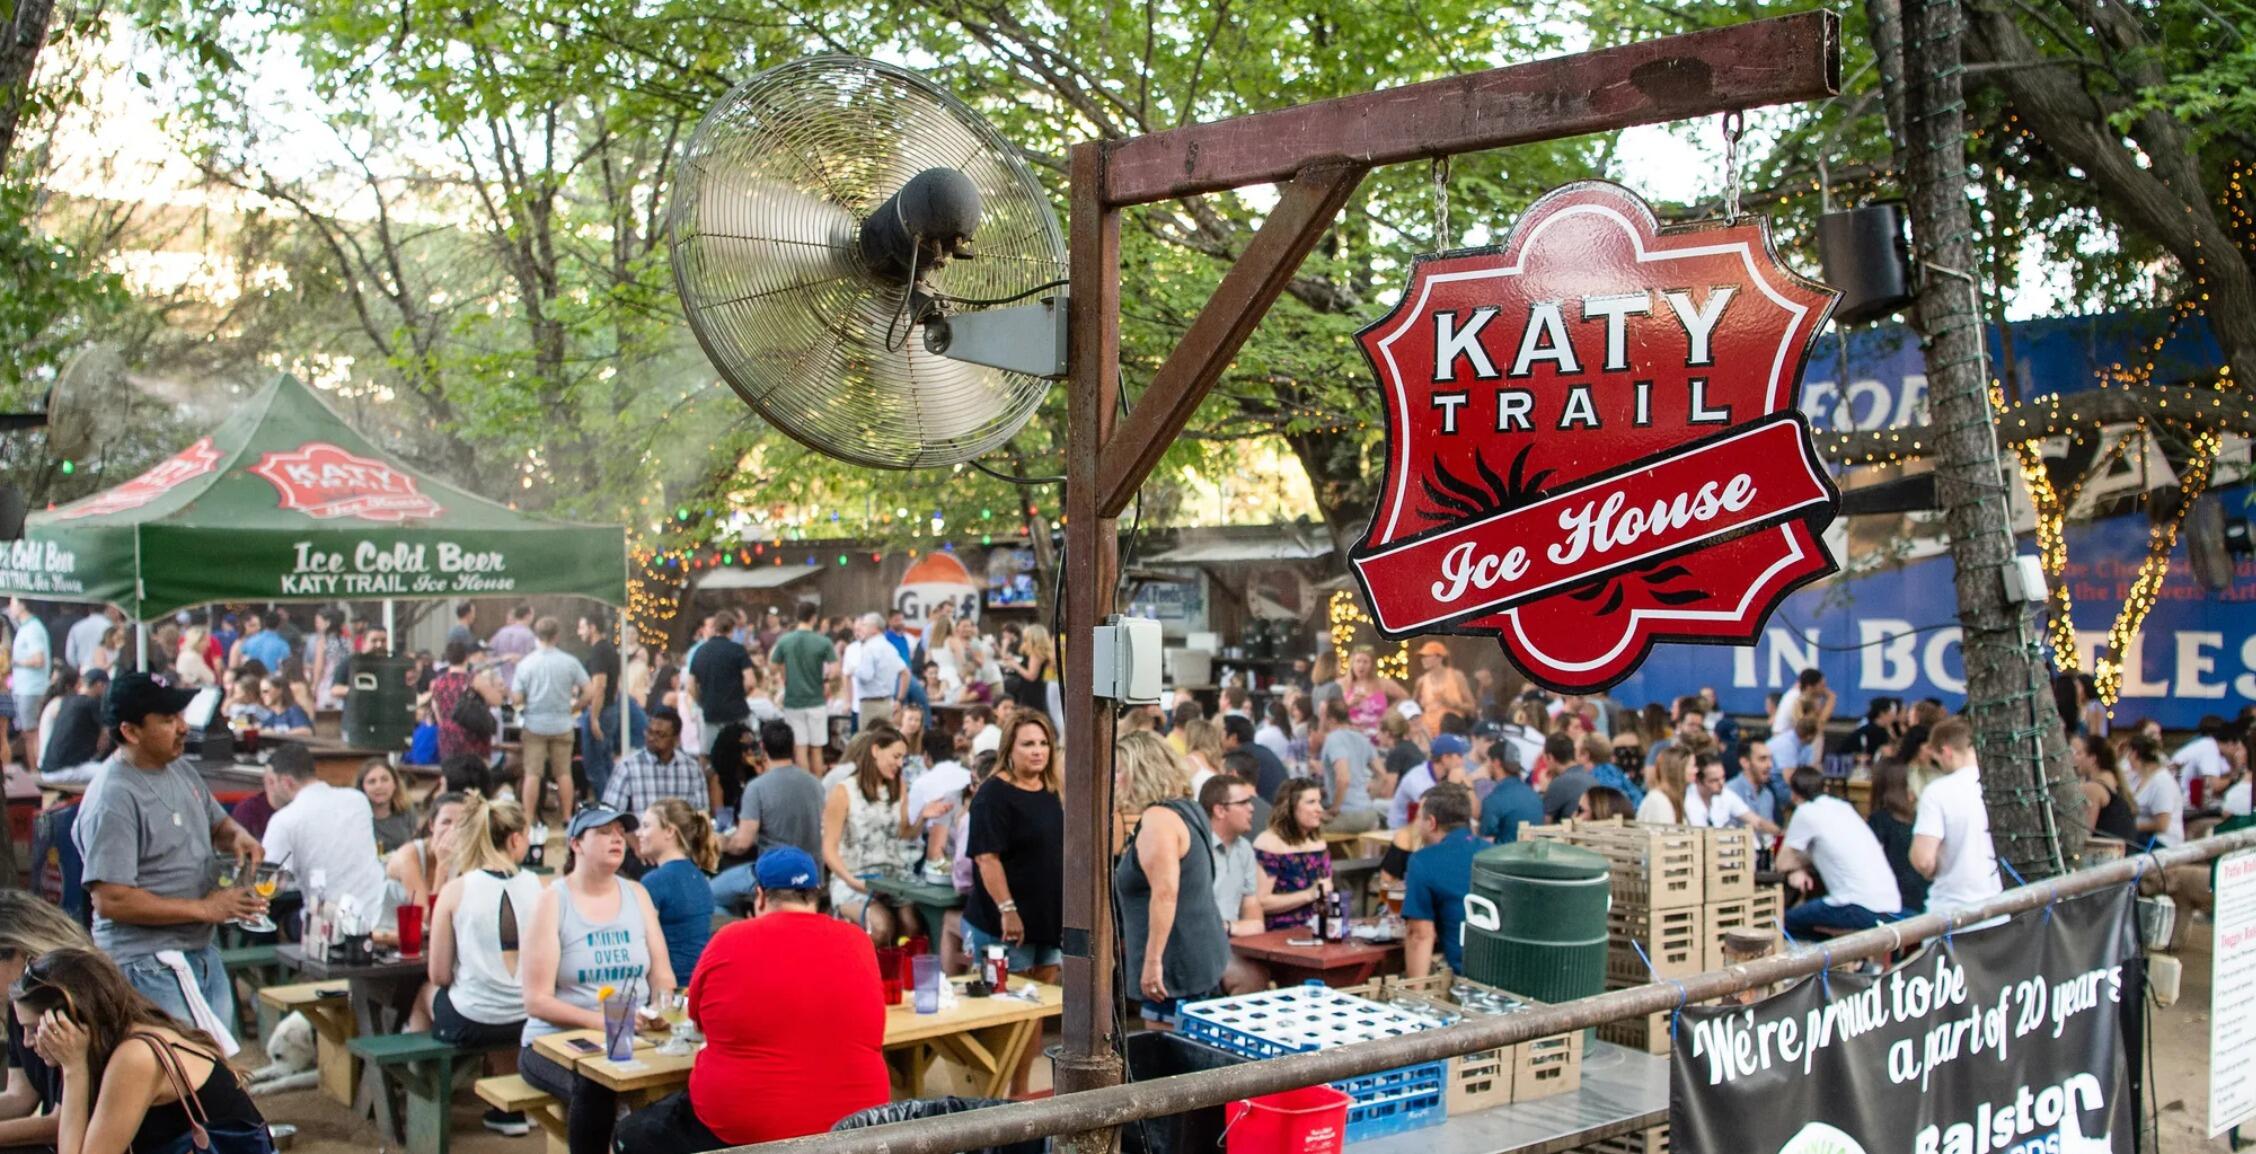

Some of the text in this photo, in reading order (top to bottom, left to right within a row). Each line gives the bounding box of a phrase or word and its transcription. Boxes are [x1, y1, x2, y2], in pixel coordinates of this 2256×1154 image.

[1432, 285, 1739, 382] KATY
[1432, 377, 1730, 435] TRAIL
[284, 463, 391, 485] KATY
[293, 540, 507, 573] Ice Cold Beer
[1431, 541, 1530, 602] Ice
[1547, 473, 1757, 565] House
[281, 574, 515, 594] KATY TRAIL Ice House
[1733, 627, 1820, 688] IN
[595, 949, 630, 965] OVER
[1693, 954, 1967, 1085] We're proud to be
[1887, 966, 2123, 1094] a part of 20 years
[1915, 1072, 2105, 1154] Ralston
